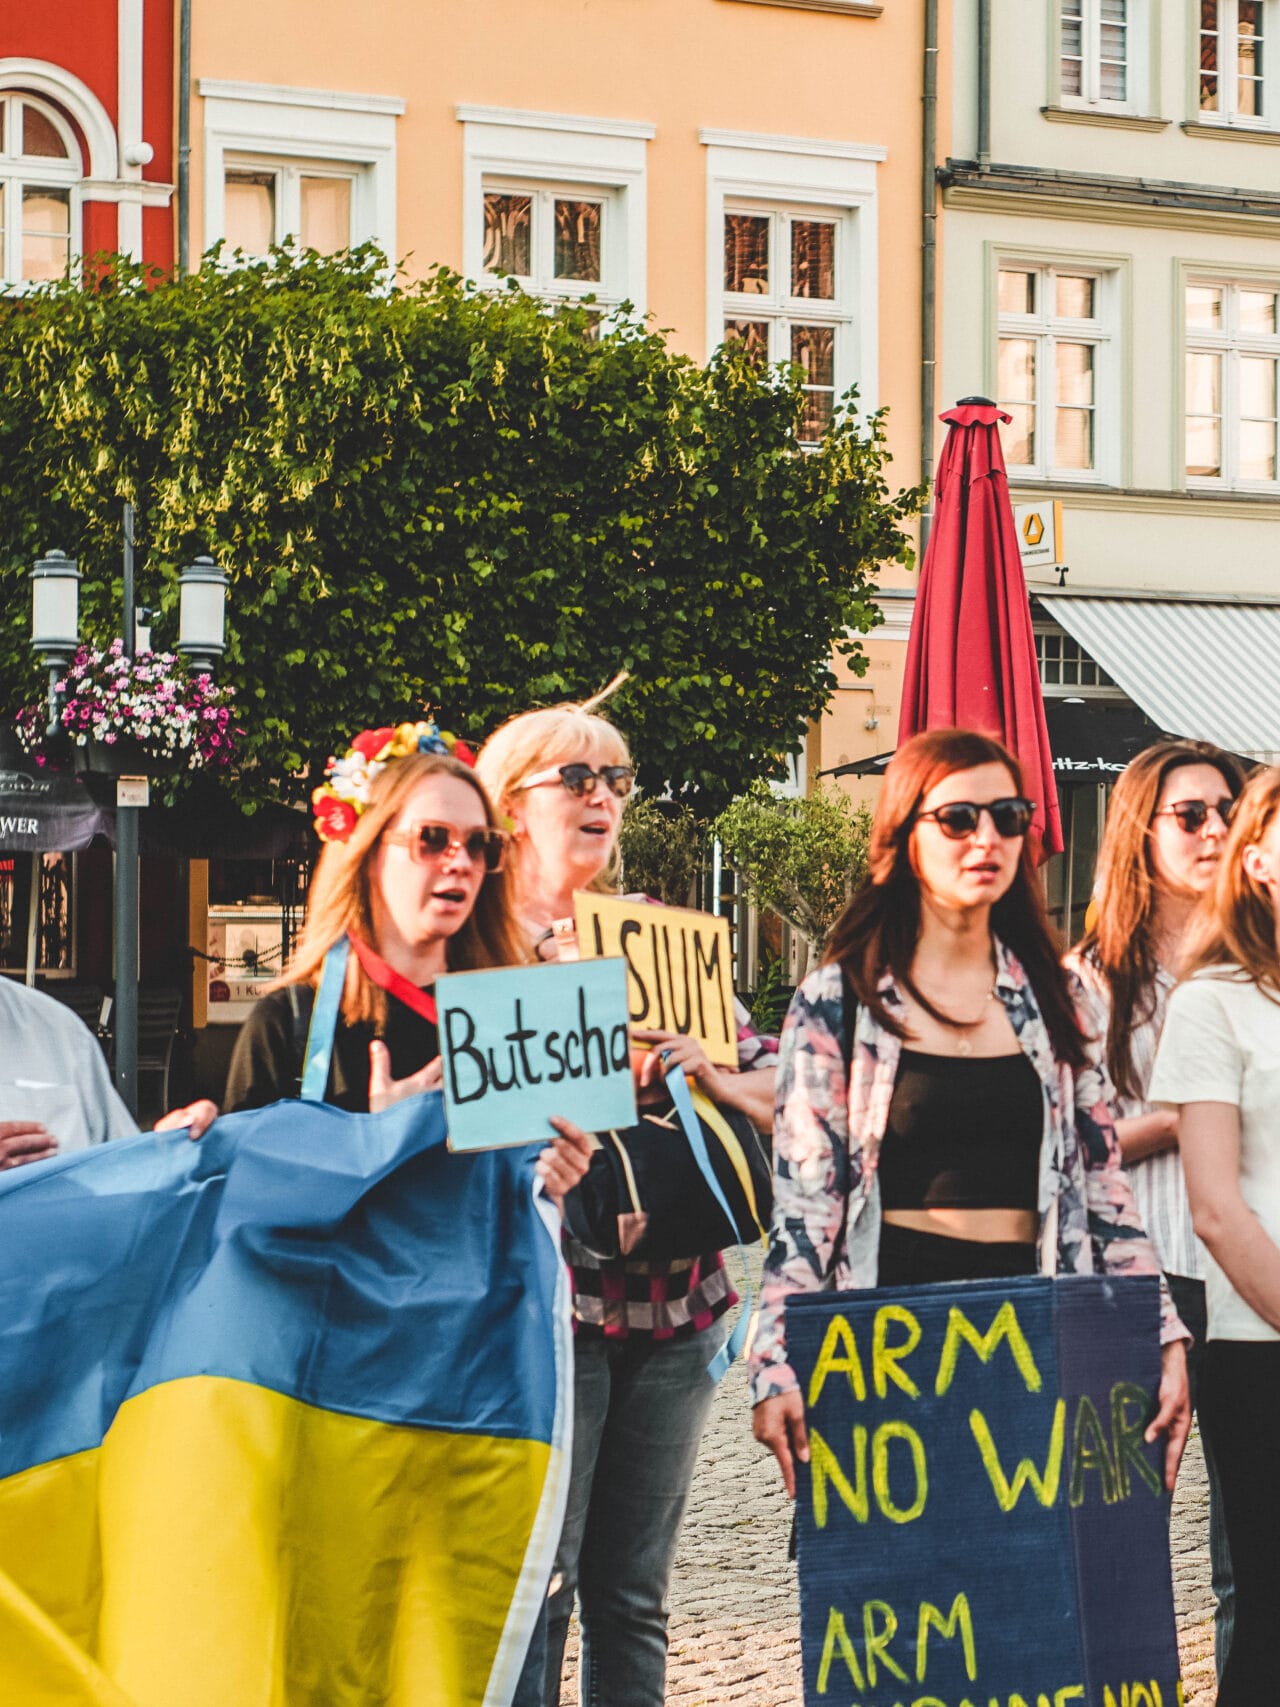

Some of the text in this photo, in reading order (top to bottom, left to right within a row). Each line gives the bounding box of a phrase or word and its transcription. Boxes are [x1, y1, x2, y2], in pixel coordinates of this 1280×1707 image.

[445, 986, 629, 1104] Butscha
[808, 1301, 1042, 1407] ARM
[809, 1382, 1164, 1529] NO WAR
[816, 1592, 978, 1695] ARM
